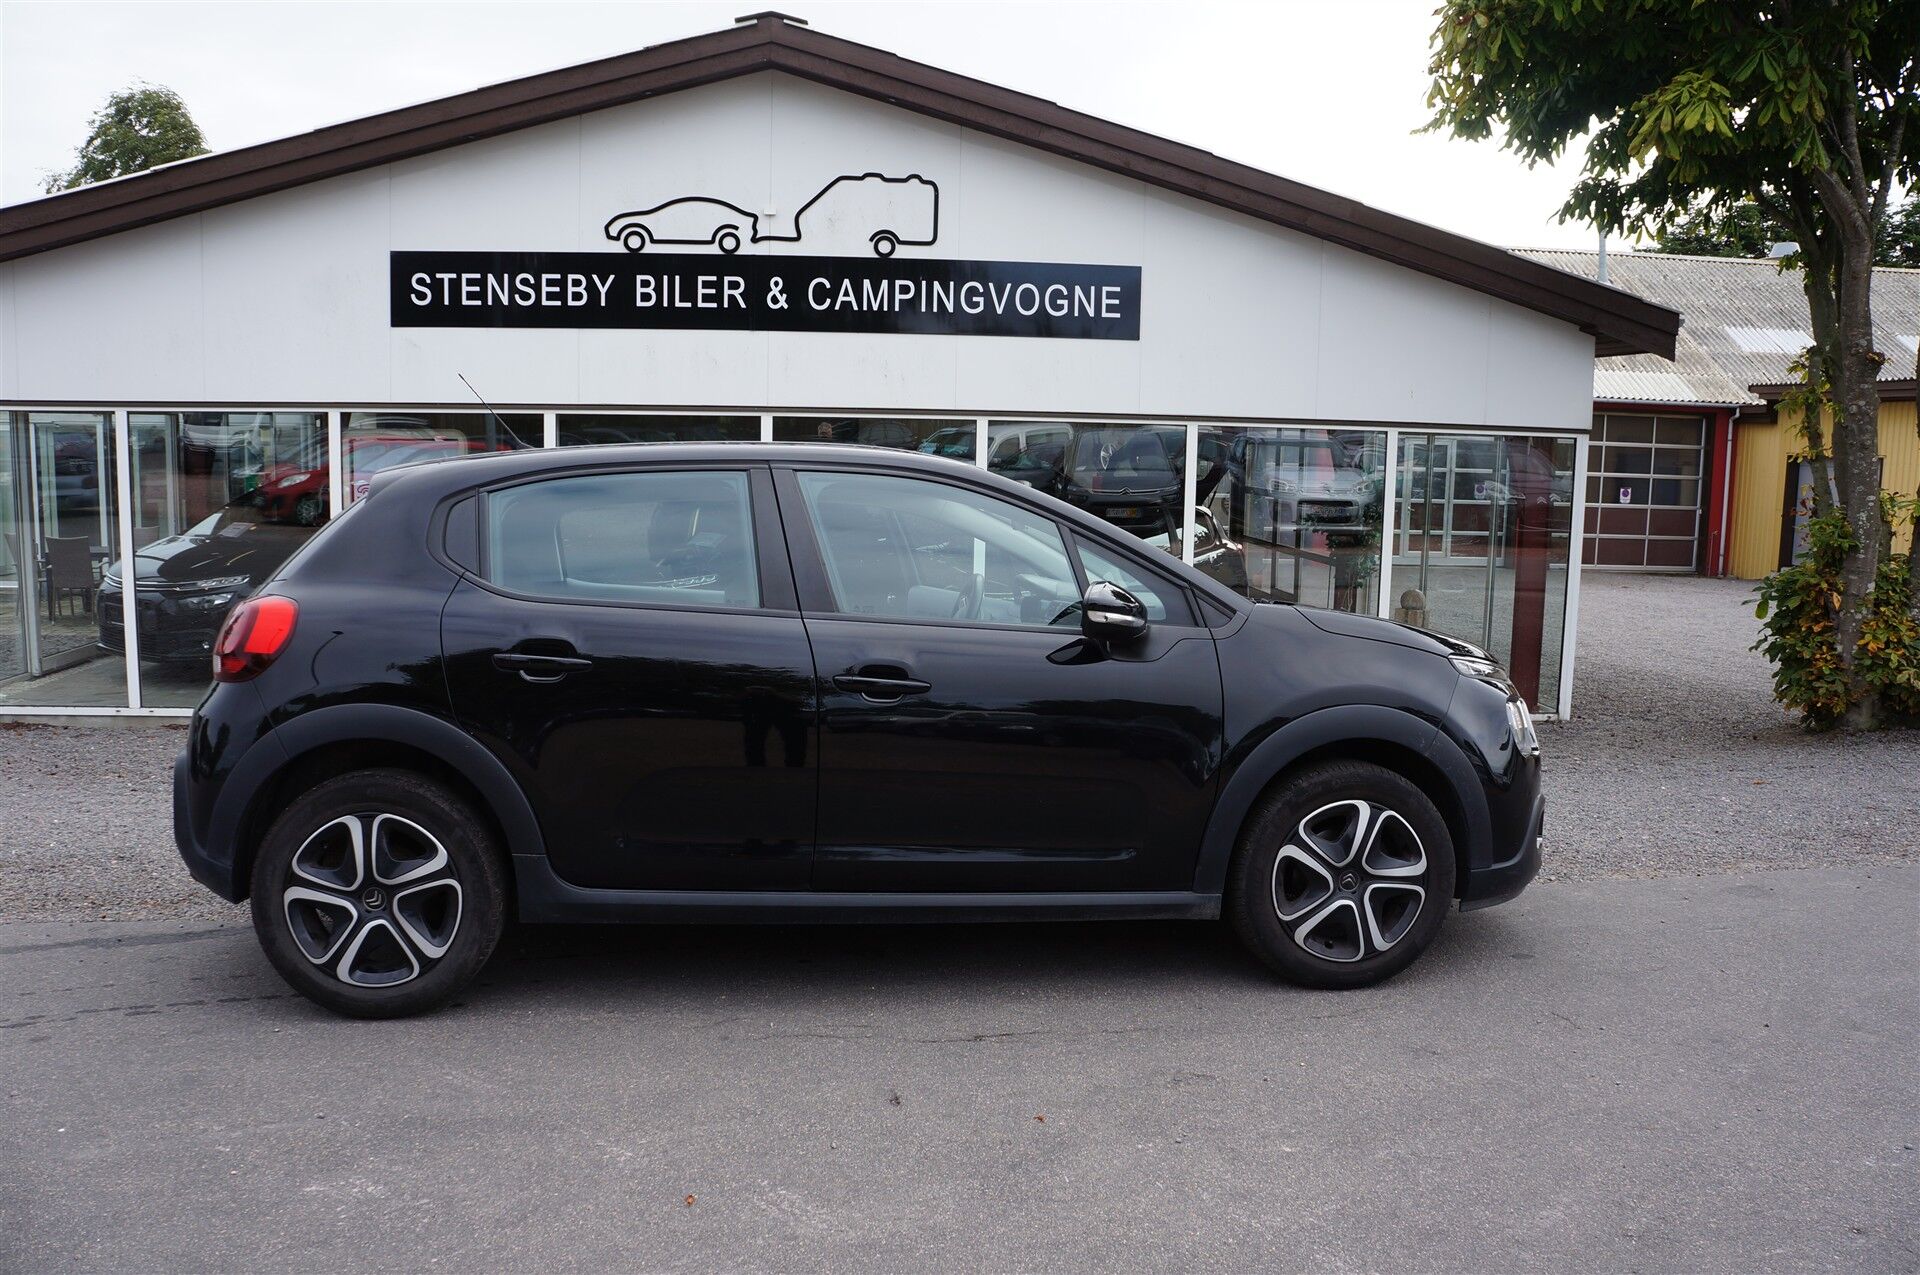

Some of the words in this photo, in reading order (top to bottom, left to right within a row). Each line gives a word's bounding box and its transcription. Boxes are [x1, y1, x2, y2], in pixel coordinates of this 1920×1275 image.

[410, 272, 616, 307] STENSEBY
[636, 274, 747, 309] BILER
[766, 276, 789, 310] &
[807, 277, 1121, 319] CAMPINGVOGNE
